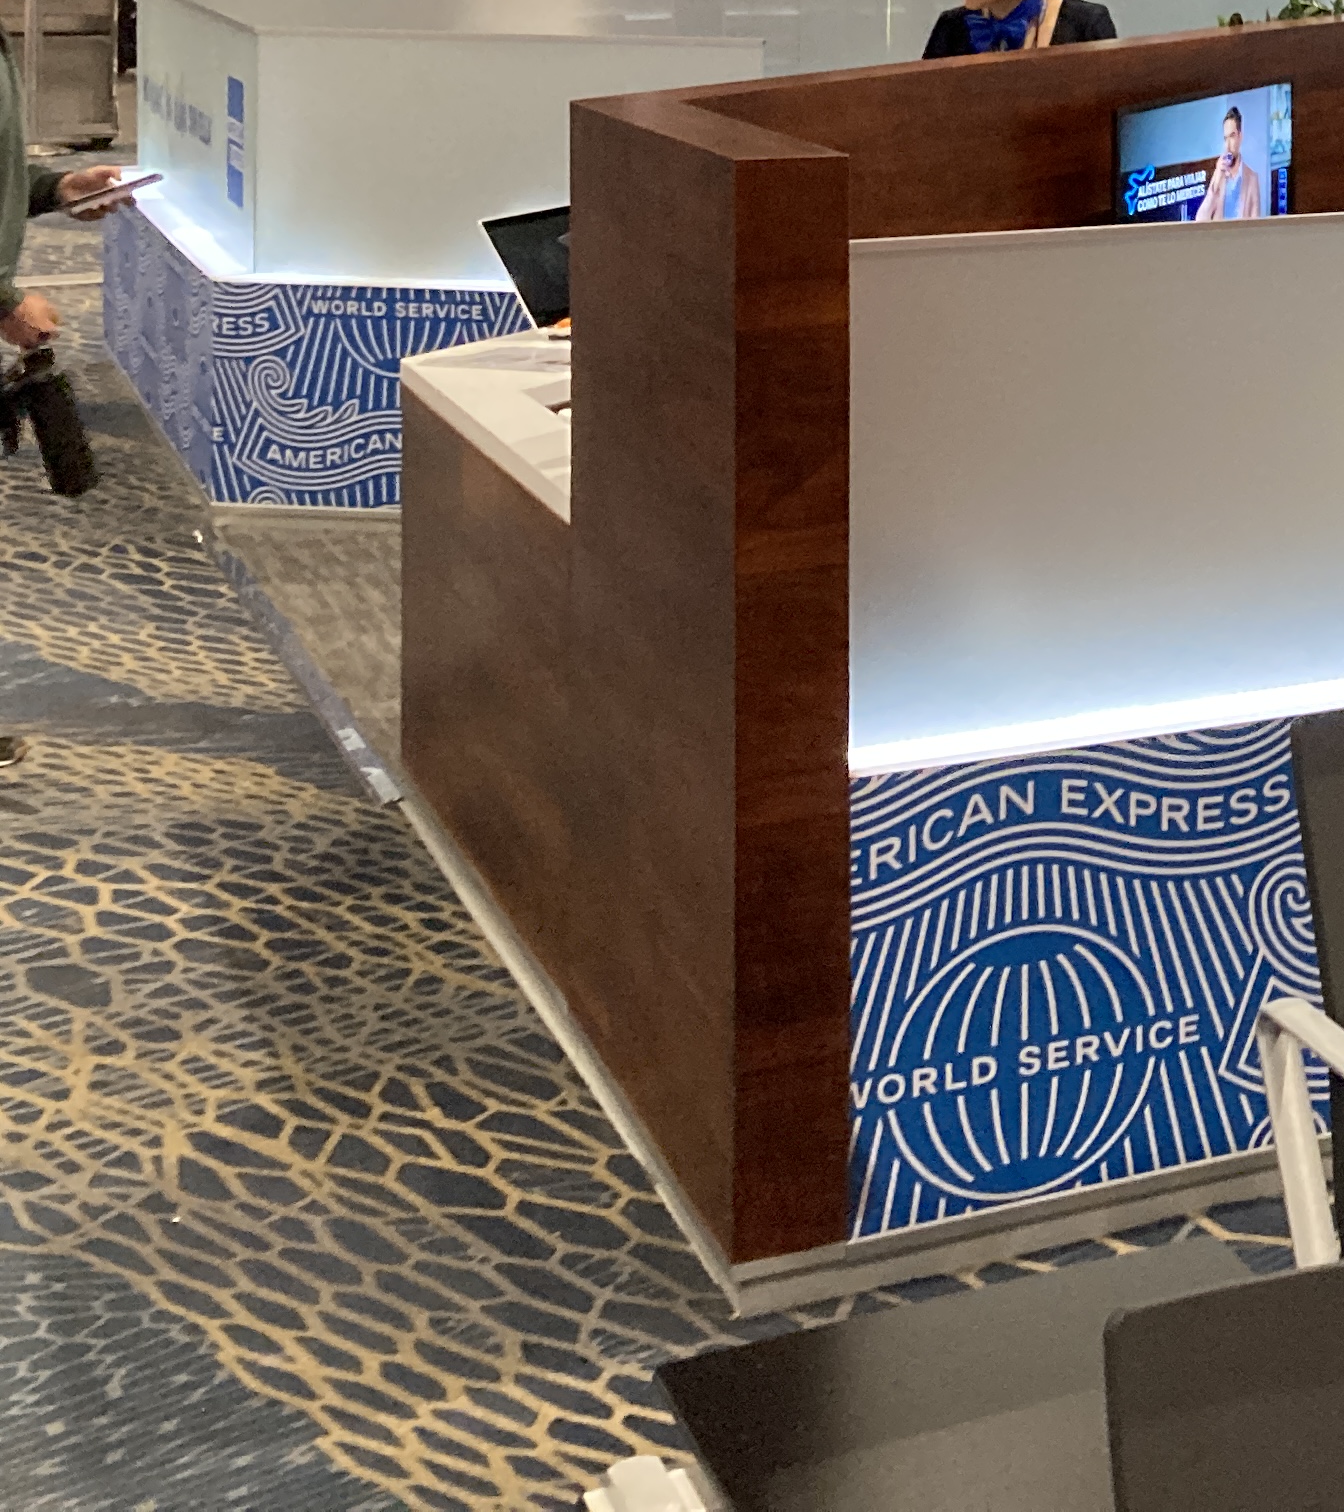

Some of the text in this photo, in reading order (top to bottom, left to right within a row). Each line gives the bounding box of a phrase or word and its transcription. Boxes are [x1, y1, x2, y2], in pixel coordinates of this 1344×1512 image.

[310, 300, 484, 320] WORLD SERVICE
[266, 432, 403, 469] AMERICAN
[1061, 774, 1290, 833] EXPRESS
[1019, 1013, 1200, 1076] SERVICE
